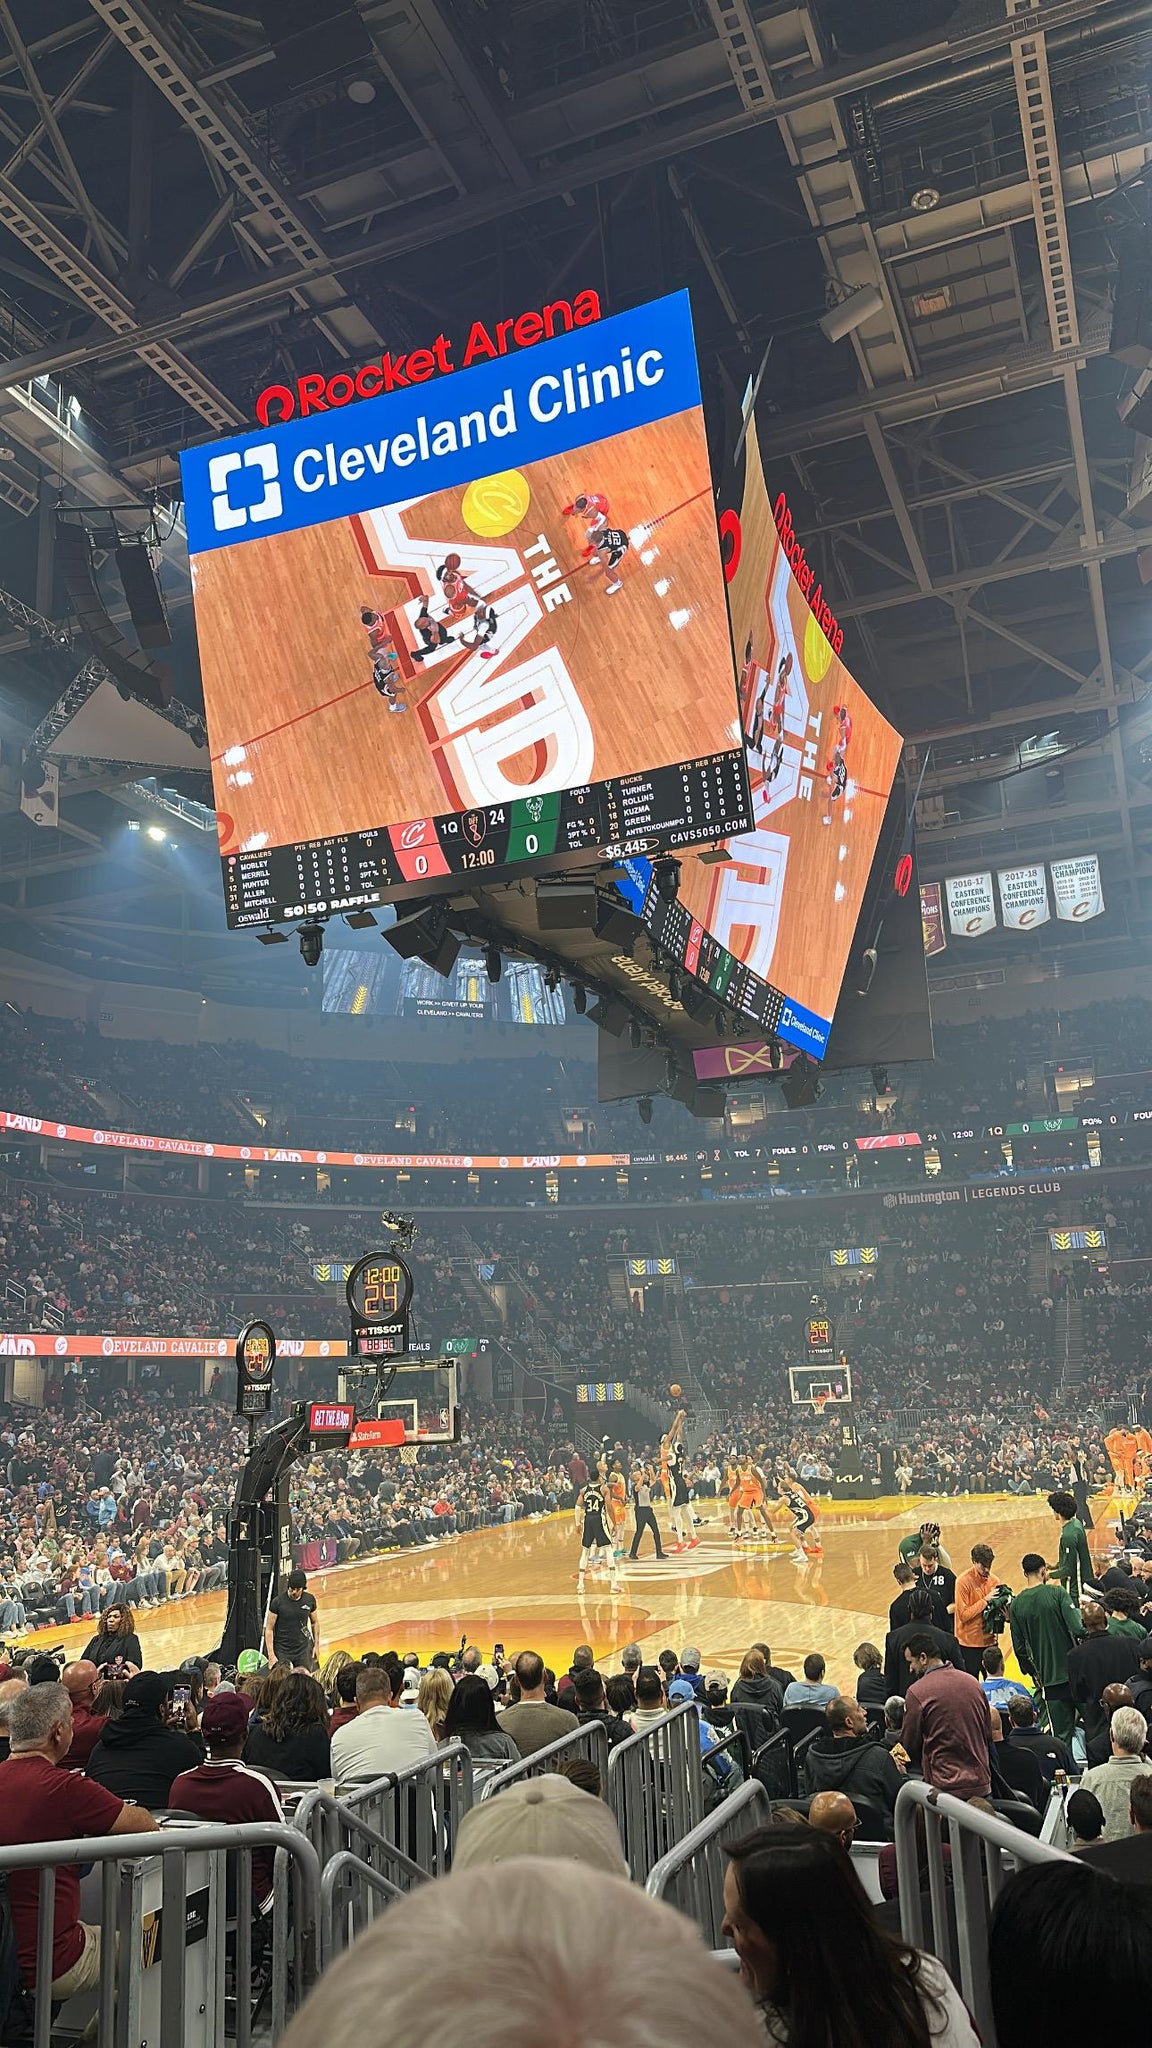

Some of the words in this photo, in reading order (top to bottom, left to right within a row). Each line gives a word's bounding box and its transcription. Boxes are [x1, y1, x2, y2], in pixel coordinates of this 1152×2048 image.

[297, 334, 453, 417] Rocket
[463, 289, 602, 366] Arena
[293, 388, 517, 493] Cleveland
[528, 346, 665, 424] Clinic
[523, 534, 572, 613] THE
[777, 506, 815, 602] Rocket
[810, 584, 843, 655] Arena
[620, 775, 642, 785] BUCKS
[679, 764, 691, 772] PTS
[695, 760, 708, 768] REB
[712, 756, 725, 764] AST
[729, 752, 740, 760] FLS
[570, 787, 590, 796] FOULS
[621, 784, 652, 796] TURNER
[578, 796, 583, 804] 0
[622, 794, 654, 806] ROLLINS
[624, 805, 650, 816] KUZMA
[685, 795, 690, 803] 0
[490, 809, 505, 825] 24
[625, 815, 651, 826] GREEN
[441, 822, 458, 834] 1Q
[670, 819, 747, 843] CAVS5050.COM
[359, 831, 378, 839] FOULS
[568, 831, 579, 839] 3PT
[367, 839, 372, 847] 0
[526, 835, 538, 853] 0
[569, 841, 582, 849] TOL
[596, 836, 600, 844] 7
[606, 839, 647, 859] $6,445
[240, 851, 272, 861] CAVALIERS
[462, 849, 494, 868] 12:00
[241, 861, 267, 871] MOBLEY
[416, 856, 427, 874] 0
[242, 870, 270, 880] MERRILL
[1005, 870, 1037, 881] 2017-18
[1055, 866, 1096, 878] CHAMPIONS
[243, 879, 269, 889] HUNTER
[953, 878, 983, 888] 2016-17
[1007, 880, 1037, 891] EASTERN
[244, 890, 265, 898] ALLEN
[955, 888, 984, 899] EASTERN
[1003, 888, 1045, 900] CONFERENCE
[245, 897, 276, 908] MITCHELL
[331, 893, 380, 909] RAFFLE
[951, 896, 991, 908] CONFERENCE
[1005, 897, 1044, 909] CHAMPIONS
[238, 909, 269, 923] oswald
[953, 904, 990, 916] CHAMPIONS
[791, 1016, 813, 1037] Cleveland
[812, 1029, 825, 1044] Clinic
[1110, 1115, 1117, 1124] 0
[1134, 1111, 1152, 1120] FOU
[952, 1131, 973, 1139] 12:00
[988, 1127, 1002, 1136] 1Q
[1022, 1124, 1029, 1133] 0
[5, 1112, 42, 1133] LAND
[104, 1135, 155, 1149] EVELAND
[158, 1140, 201, 1153] CAVALIE
[363, 1156, 412, 1166] EVELAND
[416, 1157, 462, 1167] CAVALIE
[523, 1156, 560, 1167] LAND
[734, 1150, 749, 1158] TOL
[772, 1147, 796, 1155] FOULS
[803, 1145, 808, 1153] 0
[665, 1153, 688, 1163] $6,445
[898, 1189, 960, 1205] Huntington
[972, 1185, 1026, 1199] LEGENDS
[1028, 1182, 1061, 1194] CLUB
[366, 1266, 400, 1284] 12:00
[364, 1283, 398, 1315] 24
[368, 1325, 403, 1335] TISSOT
[809, 1330, 829, 1344] 24
[113, 1340, 167, 1354] EVELAND
[171, 1341, 218, 1355] CAVALIE
[446, 1341, 453, 1351] 0
[251, 1383, 271, 1391] TISSOT
[314, 1409, 326, 1426] GET
[586, 1499, 599, 1513] 34
[932, 1575, 945, 1586] 18
